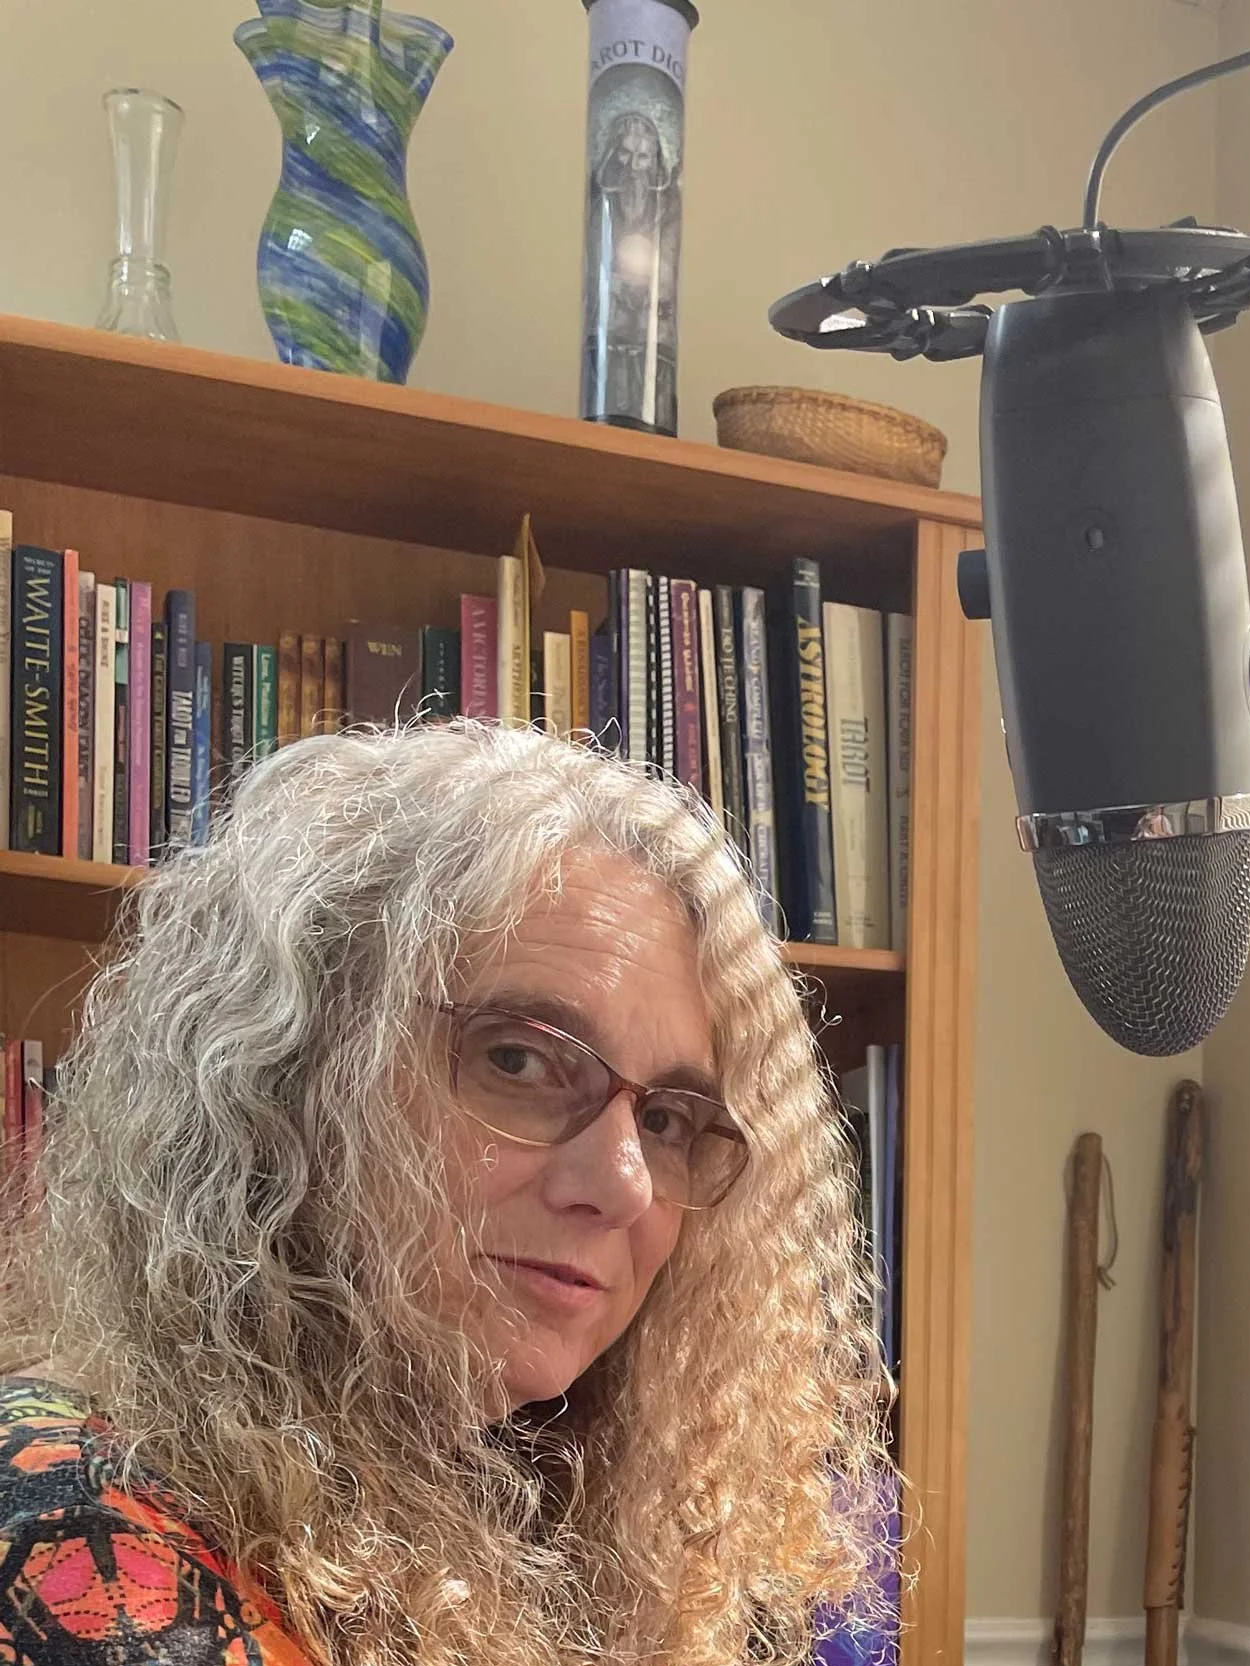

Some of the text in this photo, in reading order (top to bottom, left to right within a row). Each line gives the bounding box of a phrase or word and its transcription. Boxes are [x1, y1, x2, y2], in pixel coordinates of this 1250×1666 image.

[22, 578, 52, 786] WAITE-SMITH
[171, 690, 193, 730] TAROT
[796, 614, 830, 812] ASTROLOGY
[840, 716, 870, 793] TAROT
